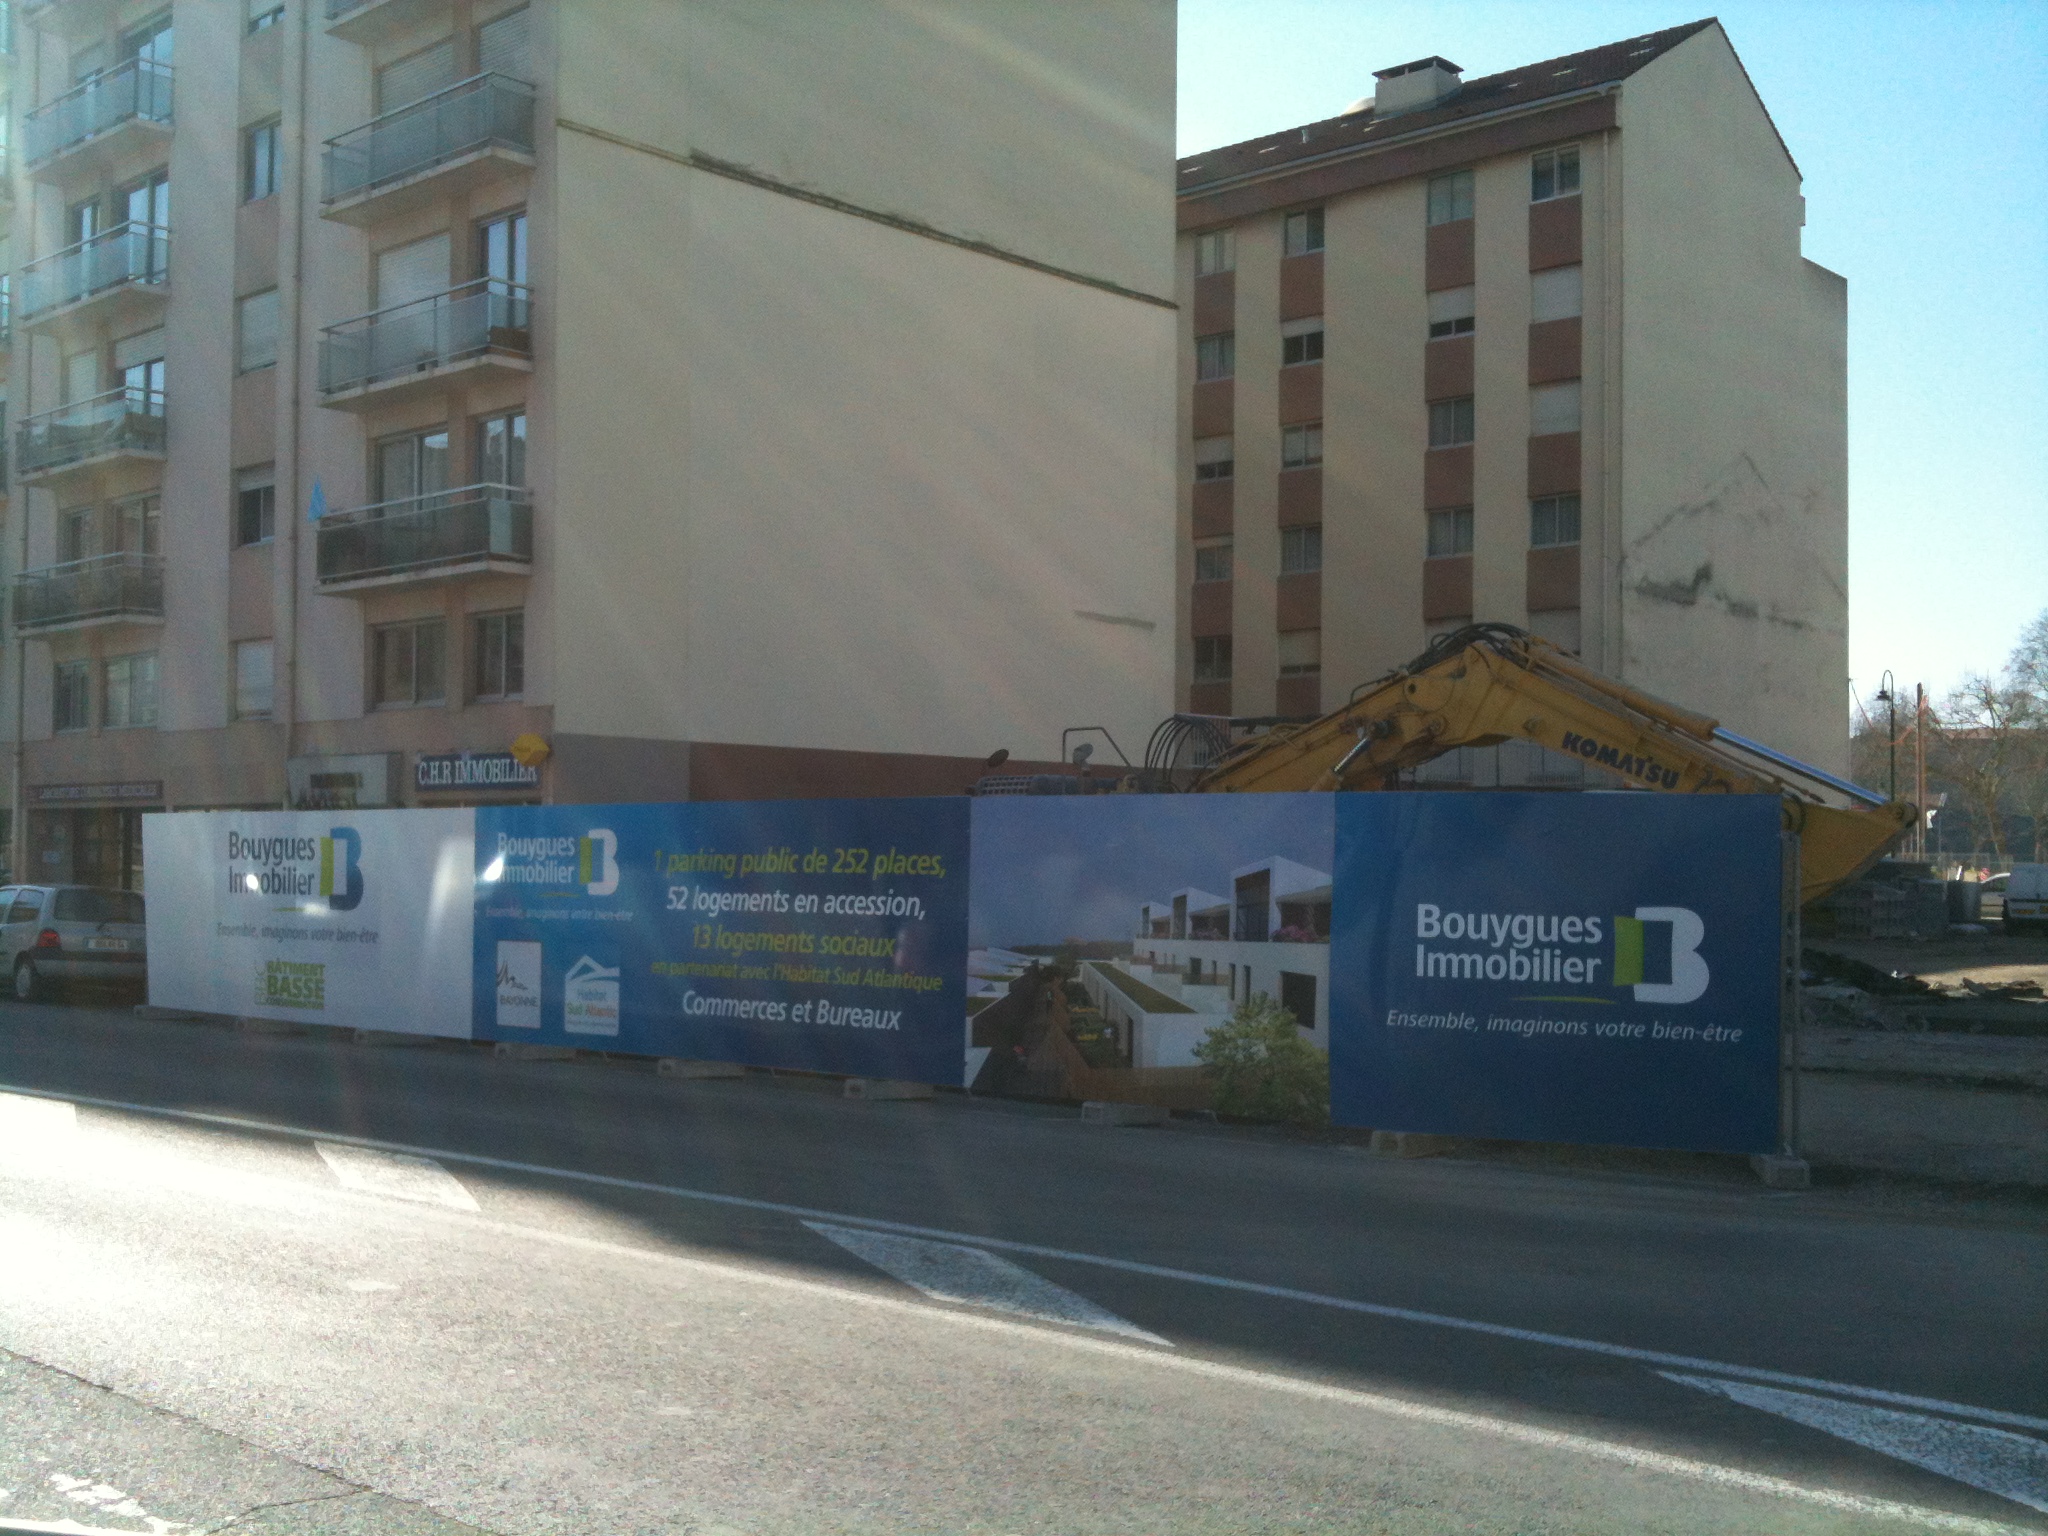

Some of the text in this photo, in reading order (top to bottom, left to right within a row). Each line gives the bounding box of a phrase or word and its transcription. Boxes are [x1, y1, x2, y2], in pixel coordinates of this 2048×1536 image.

[228, 831, 316, 866] Bouygues
[498, 832, 576, 861] Bouygues
[655, 847, 946, 880] 1 parking public de 252 places,
[667, 885, 926, 921] 52 logements en accession,
[693, 924, 713, 948] 13
[716, 924, 815, 957] logements
[1417, 903, 1603, 949] Bouygues
[740, 965, 770, 979] avec
[832, 966, 860, 985] Sud
[862, 968, 942, 994] Atlantique
[1416, 944, 1602, 984] Immobilier
[267, 974, 325, 1000] BASSE
[683, 990, 902, 1031] Commerces et Bureaux
[1386, 1009, 1743, 1043] Ensemble, imaginons votre bien-être
